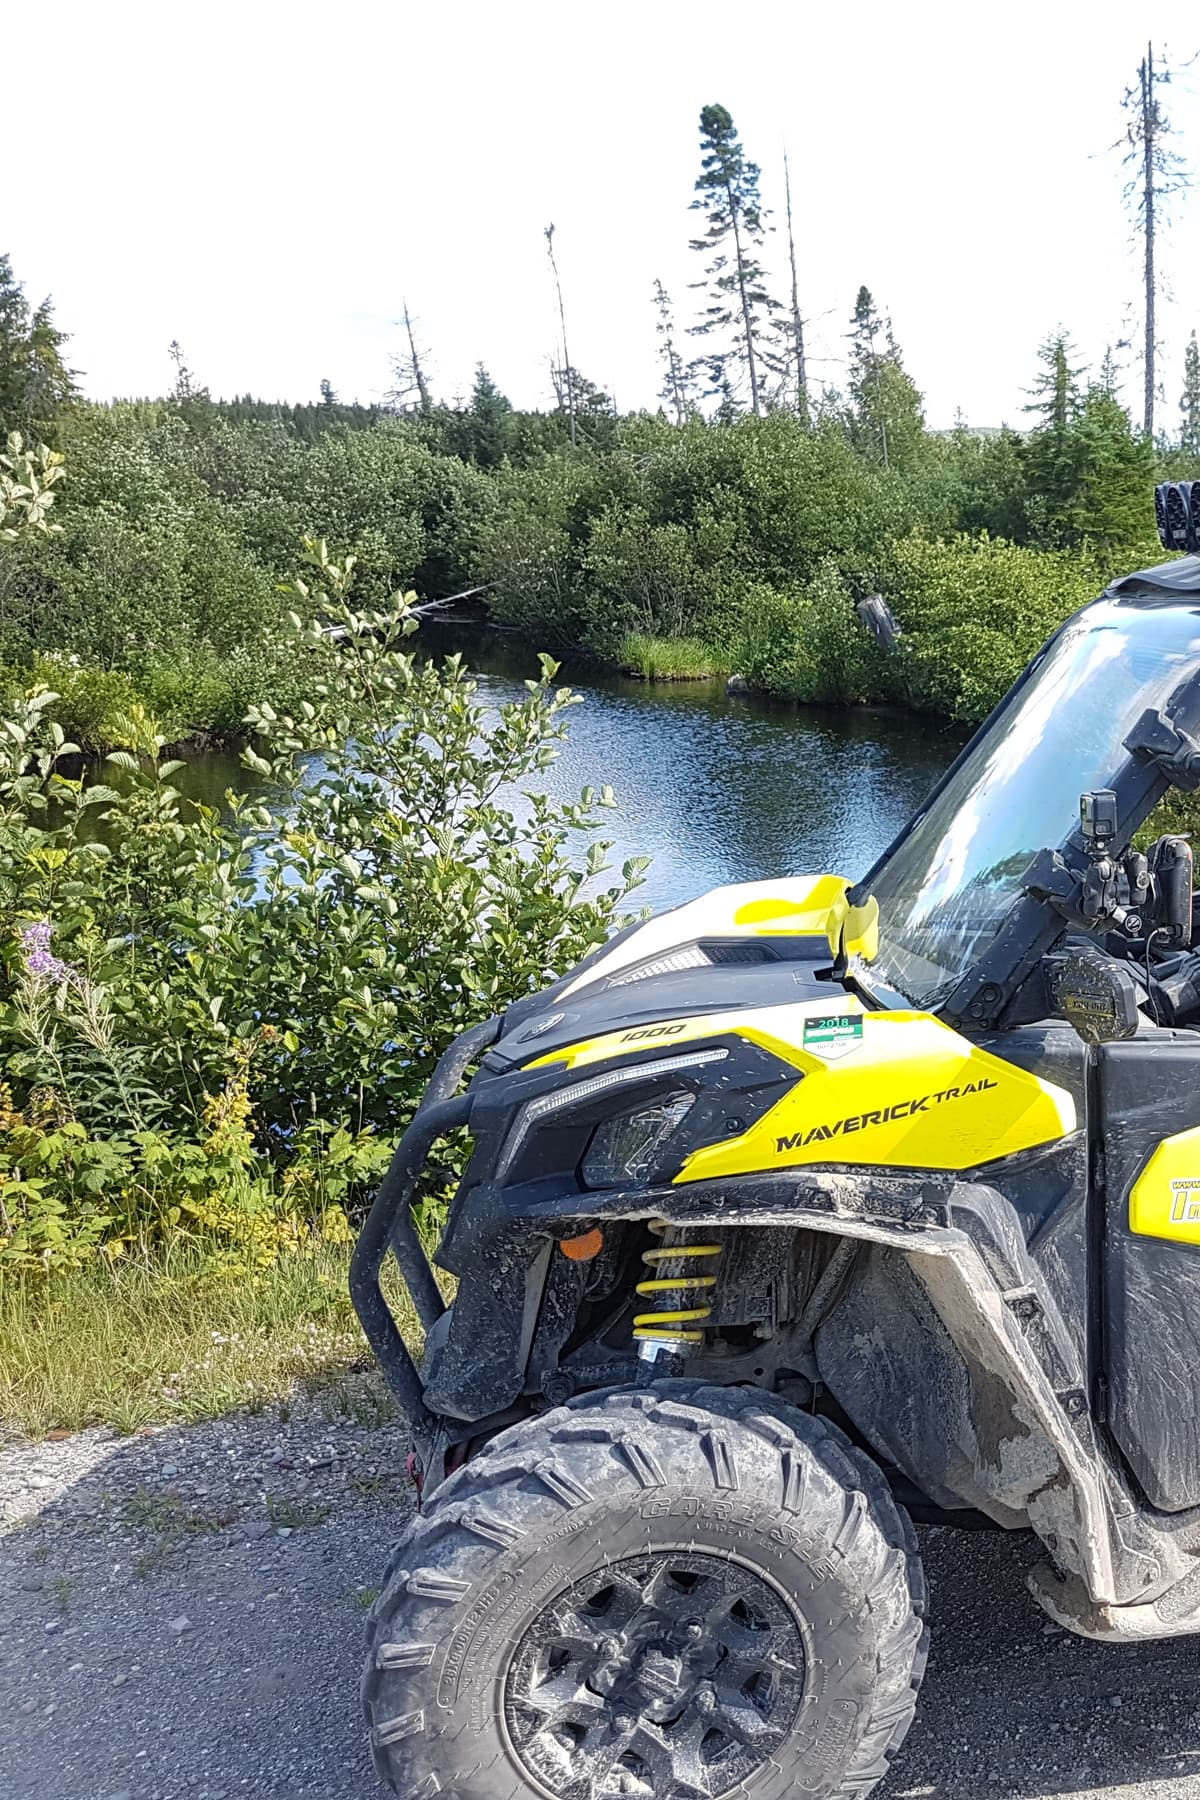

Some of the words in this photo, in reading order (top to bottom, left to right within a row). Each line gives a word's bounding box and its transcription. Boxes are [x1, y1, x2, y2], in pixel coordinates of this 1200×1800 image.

[620, 1024, 687, 1043] 1000
[818, 1017, 849, 1029] 2018
[775, 1095, 931, 1153] MAVERICK
[932, 1078, 998, 1103] TRAIL
[640, 1496, 838, 1581] CARLISLE
